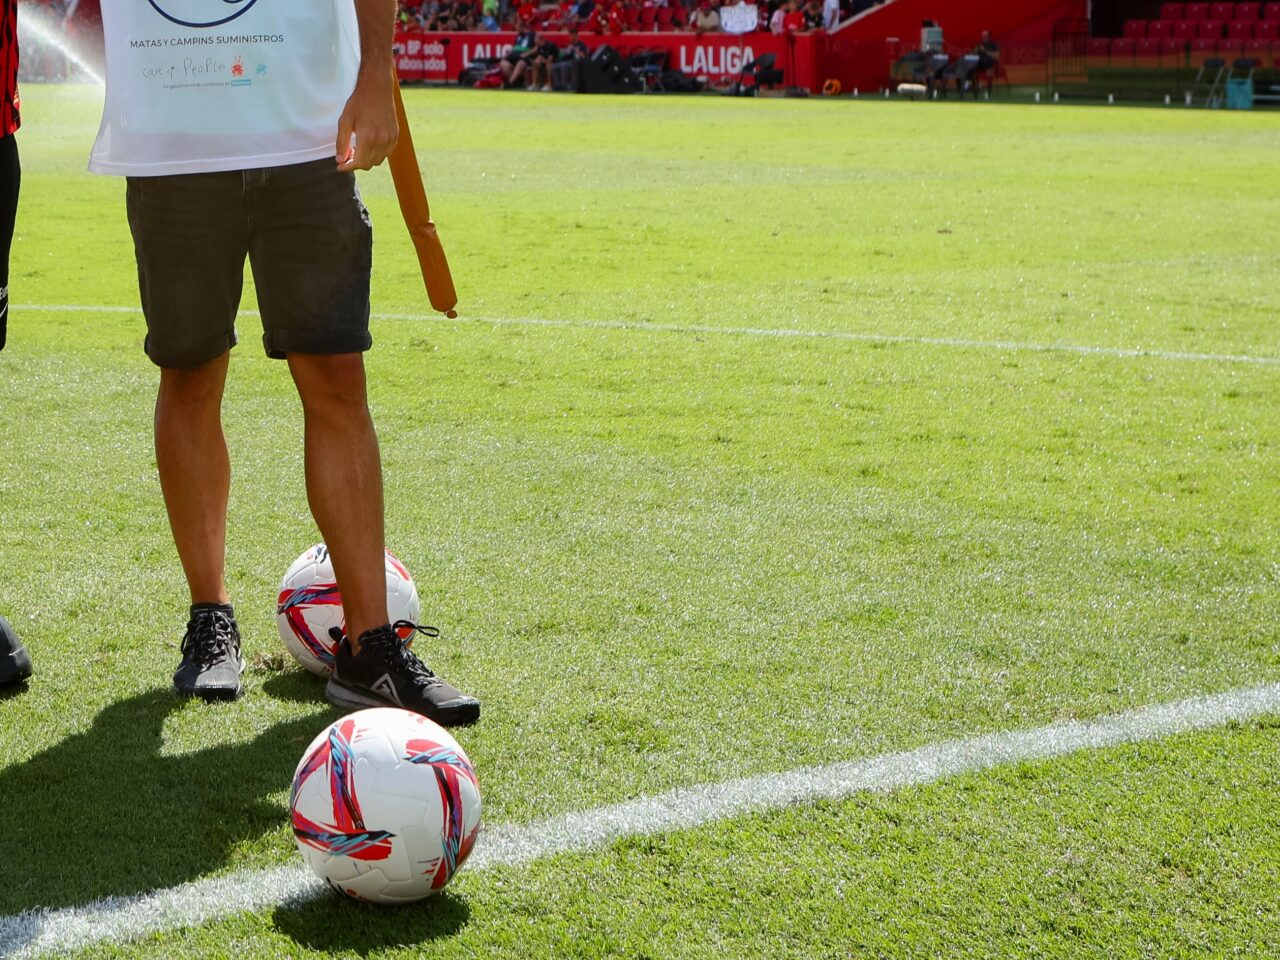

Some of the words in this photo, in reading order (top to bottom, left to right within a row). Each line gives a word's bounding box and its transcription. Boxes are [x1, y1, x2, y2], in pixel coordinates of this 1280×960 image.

[130, 39, 162, 49] MATAS
[170, 37, 214, 46] CAMPINS
[216, 34, 284, 45] SUMINISTROS
[681, 45, 755, 75] LALIGA
